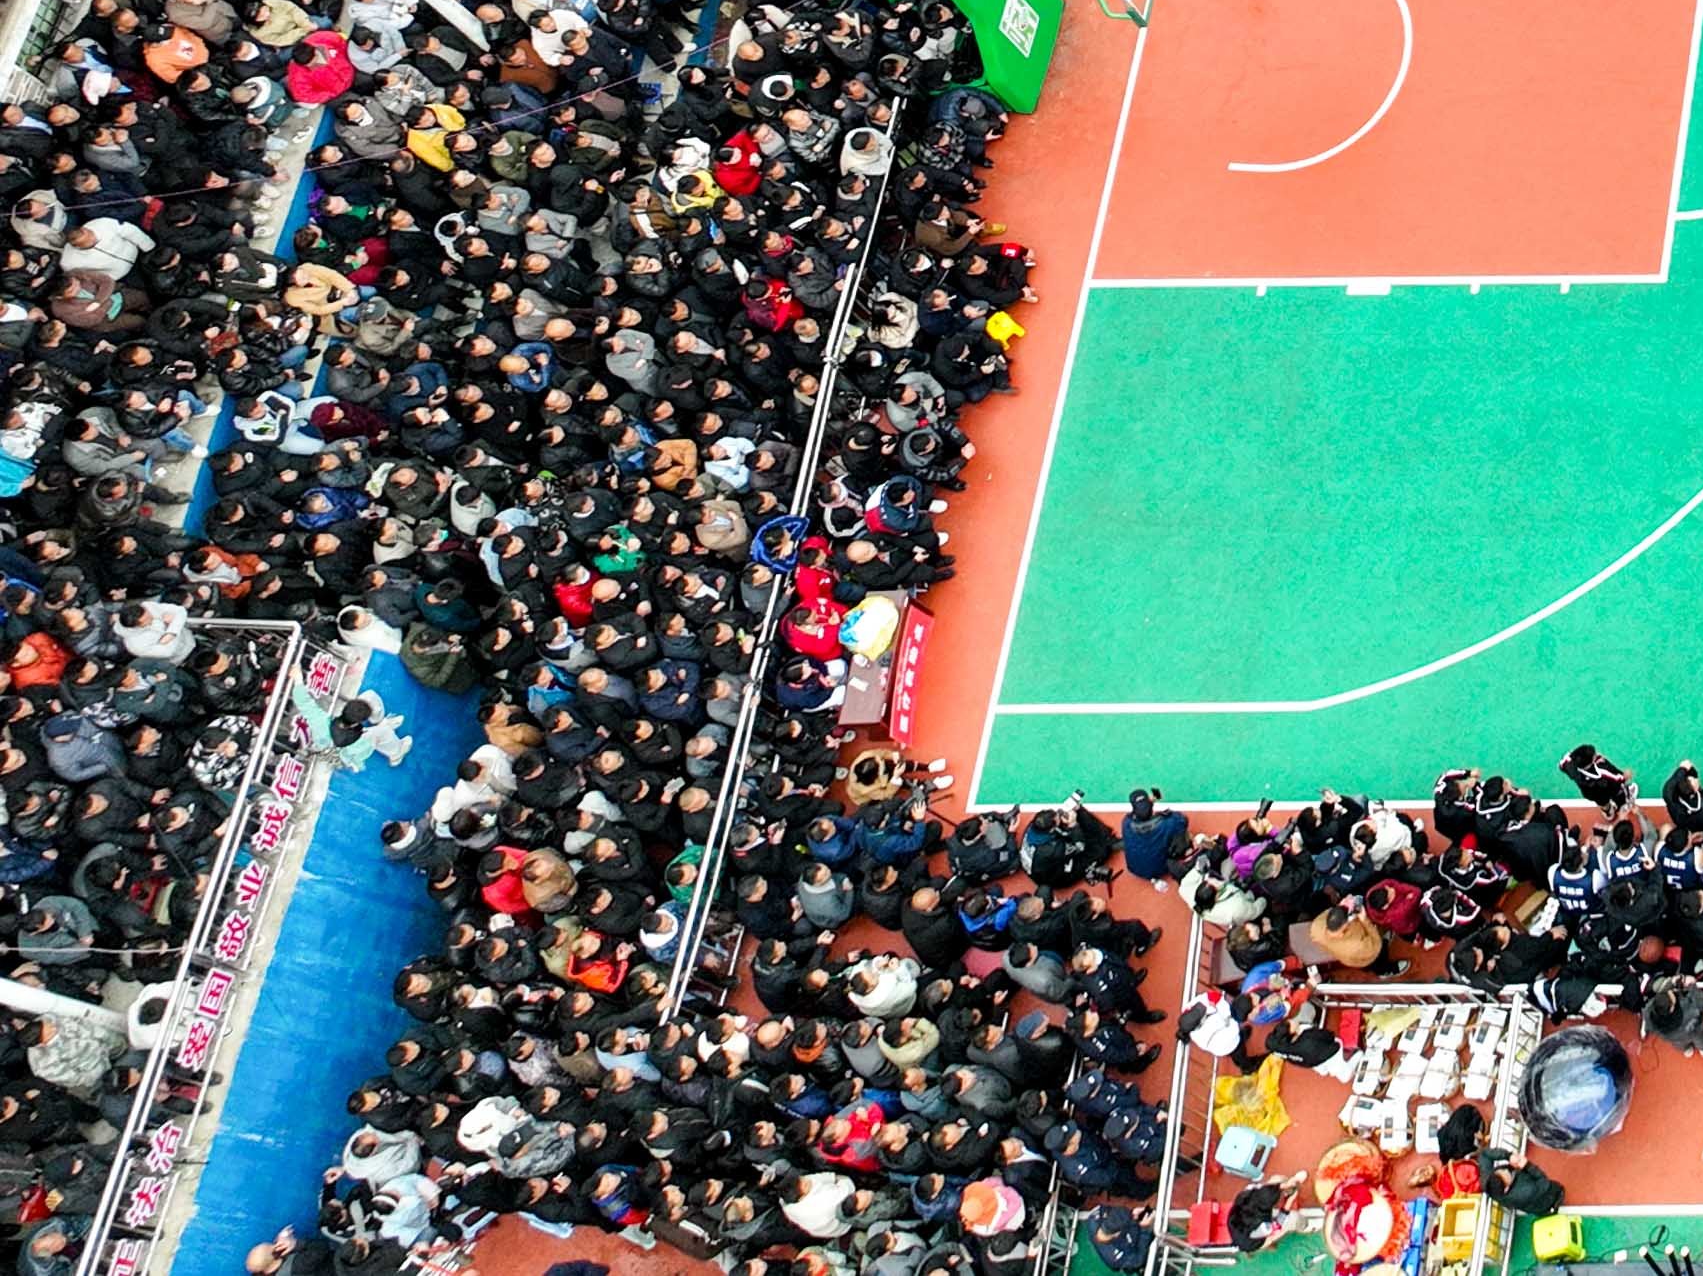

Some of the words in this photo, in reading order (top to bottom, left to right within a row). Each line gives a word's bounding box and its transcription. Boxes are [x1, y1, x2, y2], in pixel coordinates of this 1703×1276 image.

[178, 968, 235, 1071] 爱国
[214, 859, 268, 962] 敬业
[251, 753, 304, 852] 诚信
